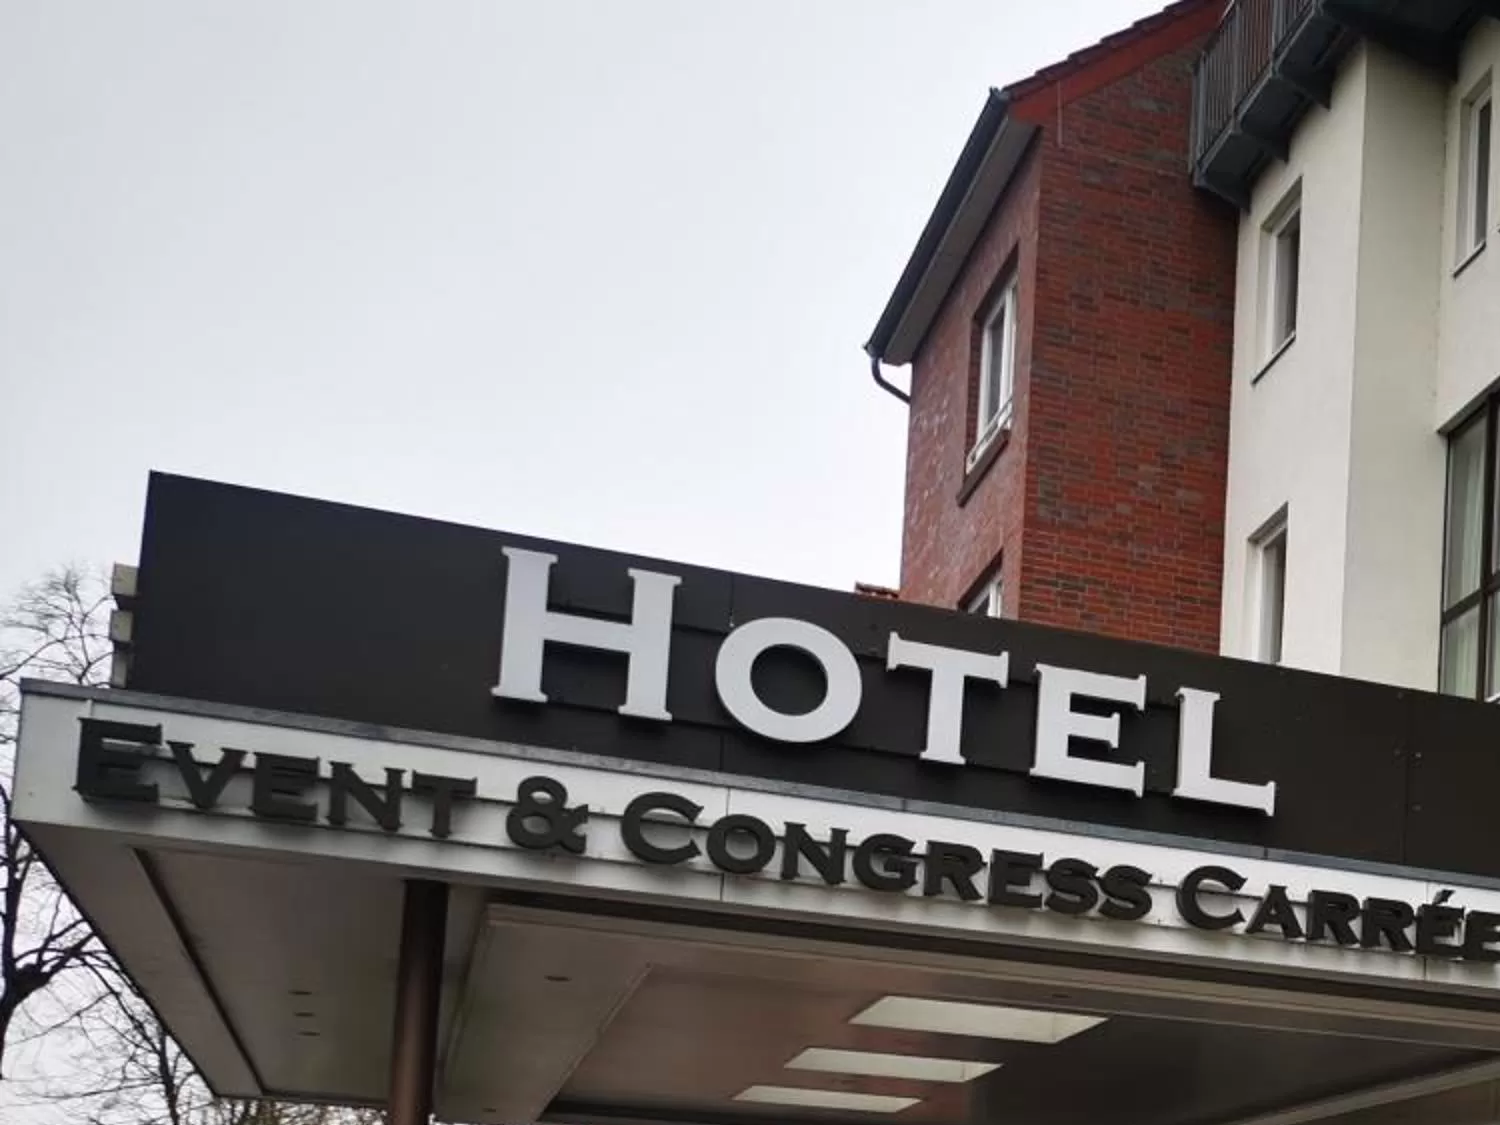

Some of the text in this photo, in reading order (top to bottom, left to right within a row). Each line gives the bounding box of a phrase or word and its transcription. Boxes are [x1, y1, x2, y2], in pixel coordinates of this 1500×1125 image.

[491, 545, 1277, 817] HOTEL
[75, 716, 478, 839] EVENT
[506, 776, 588, 855] &
[621, 790, 1153, 922] CONGRESS
